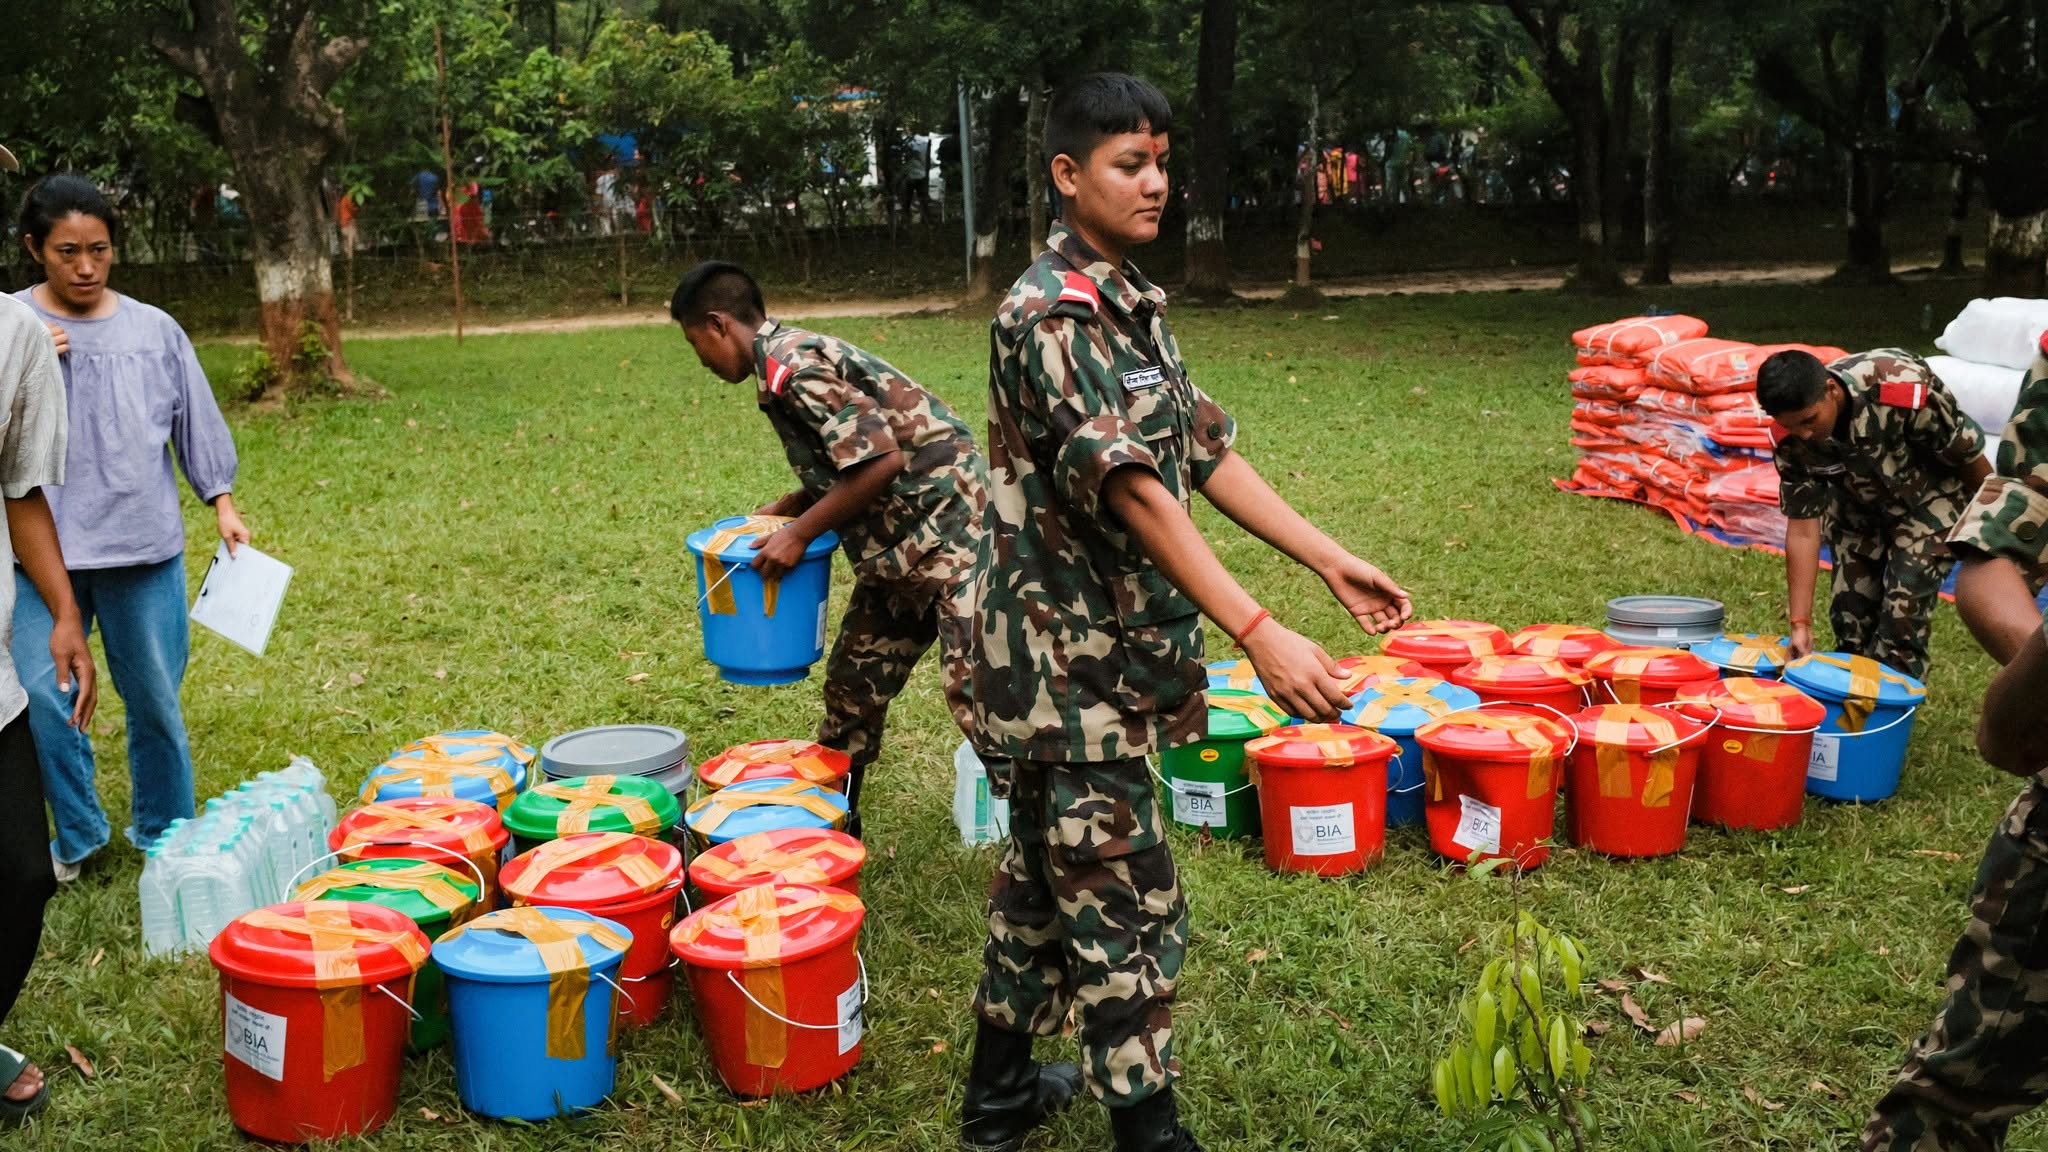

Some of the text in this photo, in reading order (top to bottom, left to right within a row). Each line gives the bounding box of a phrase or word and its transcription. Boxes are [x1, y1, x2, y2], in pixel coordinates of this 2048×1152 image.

[1812, 751, 1826, 765] IA
[1190, 797, 1214, 811] BIA
[1316, 824, 1342, 838] BIA
[1472, 817, 1488, 836] BIA
[243, 1027, 268, 1054] BIA
